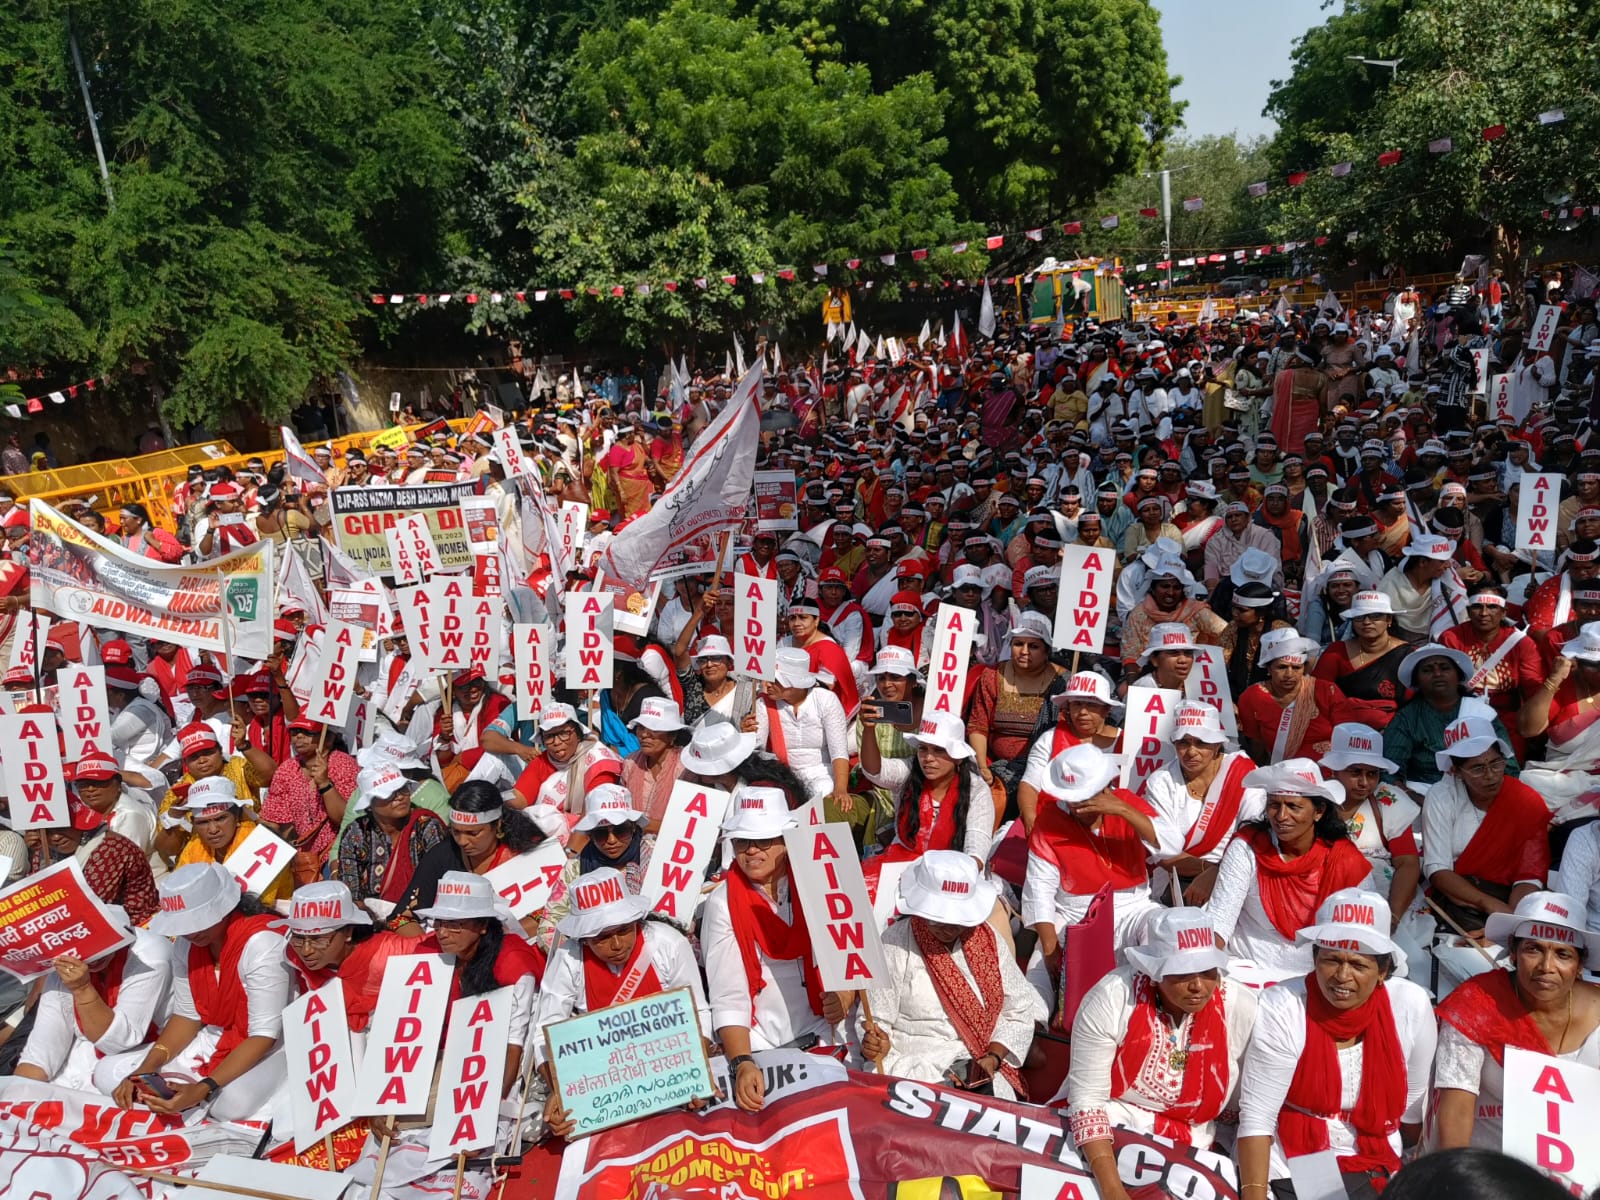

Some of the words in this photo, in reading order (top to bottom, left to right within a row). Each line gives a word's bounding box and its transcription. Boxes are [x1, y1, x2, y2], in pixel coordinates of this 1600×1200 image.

[1536, 307, 1555, 349] AIDWA
[502, 431, 521, 475] AIDWA
[336, 491, 370, 509] BJP-RSS
[397, 488, 417, 506] DESH
[1528, 476, 1549, 546] AIDWA
[408, 519, 434, 572] AIDWA
[445, 532, 463, 540] 2023
[348, 548, 363, 561] ALL
[234, 594, 254, 613] 05
[1072, 552, 1103, 647] AIDWA
[440, 582, 463, 663] AIDWA
[743, 582, 767, 674] AIDWA
[579, 597, 603, 684] AIDWA
[1163, 633, 1187, 645] AIDWA
[320, 628, 352, 720] AIDWA
[526, 628, 544, 714] AIDWA
[935, 612, 963, 712] AIDWA
[1468, 668, 1488, 687] AIDWA
[544, 711, 567, 720] AIDWA
[1348, 736, 1372, 751] AIDWA
[19, 720, 55, 823] AIDWA
[372, 771, 401, 787] AIDWA
[451, 812, 478, 824] AIDWA
[740, 799, 764, 810] AIDWA
[1197, 801, 1215, 831] AIDWA
[655, 793, 708, 917] AIDWA
[438, 884, 471, 895] AIDWA
[575, 877, 624, 911] AIDWA
[941, 879, 969, 894] AIDWA
[20, 904, 72, 936] सरकार
[812, 832, 874, 980] AIDWA
[1331, 903, 1374, 926] AIDWA
[1544, 902, 1569, 919] AIDWA
[1177, 927, 1213, 950] AIDWA
[1530, 924, 1575, 943] AIDWA
[598, 1008, 637, 1031] MODI
[641, 999, 682, 1018] GOVT.
[376, 960, 432, 1105] AIDWA
[558, 1039, 593, 1059] ANTI
[596, 1023, 651, 1047] WOMEN
[653, 1012, 689, 1032] GOVT.
[304, 993, 341, 1132] AIDWA
[608, 1042, 638, 1066] मोदी
[640, 1032, 693, 1057] सरकार
[450, 999, 494, 1146] AIDWA
[150, 1141, 169, 1162] 5
